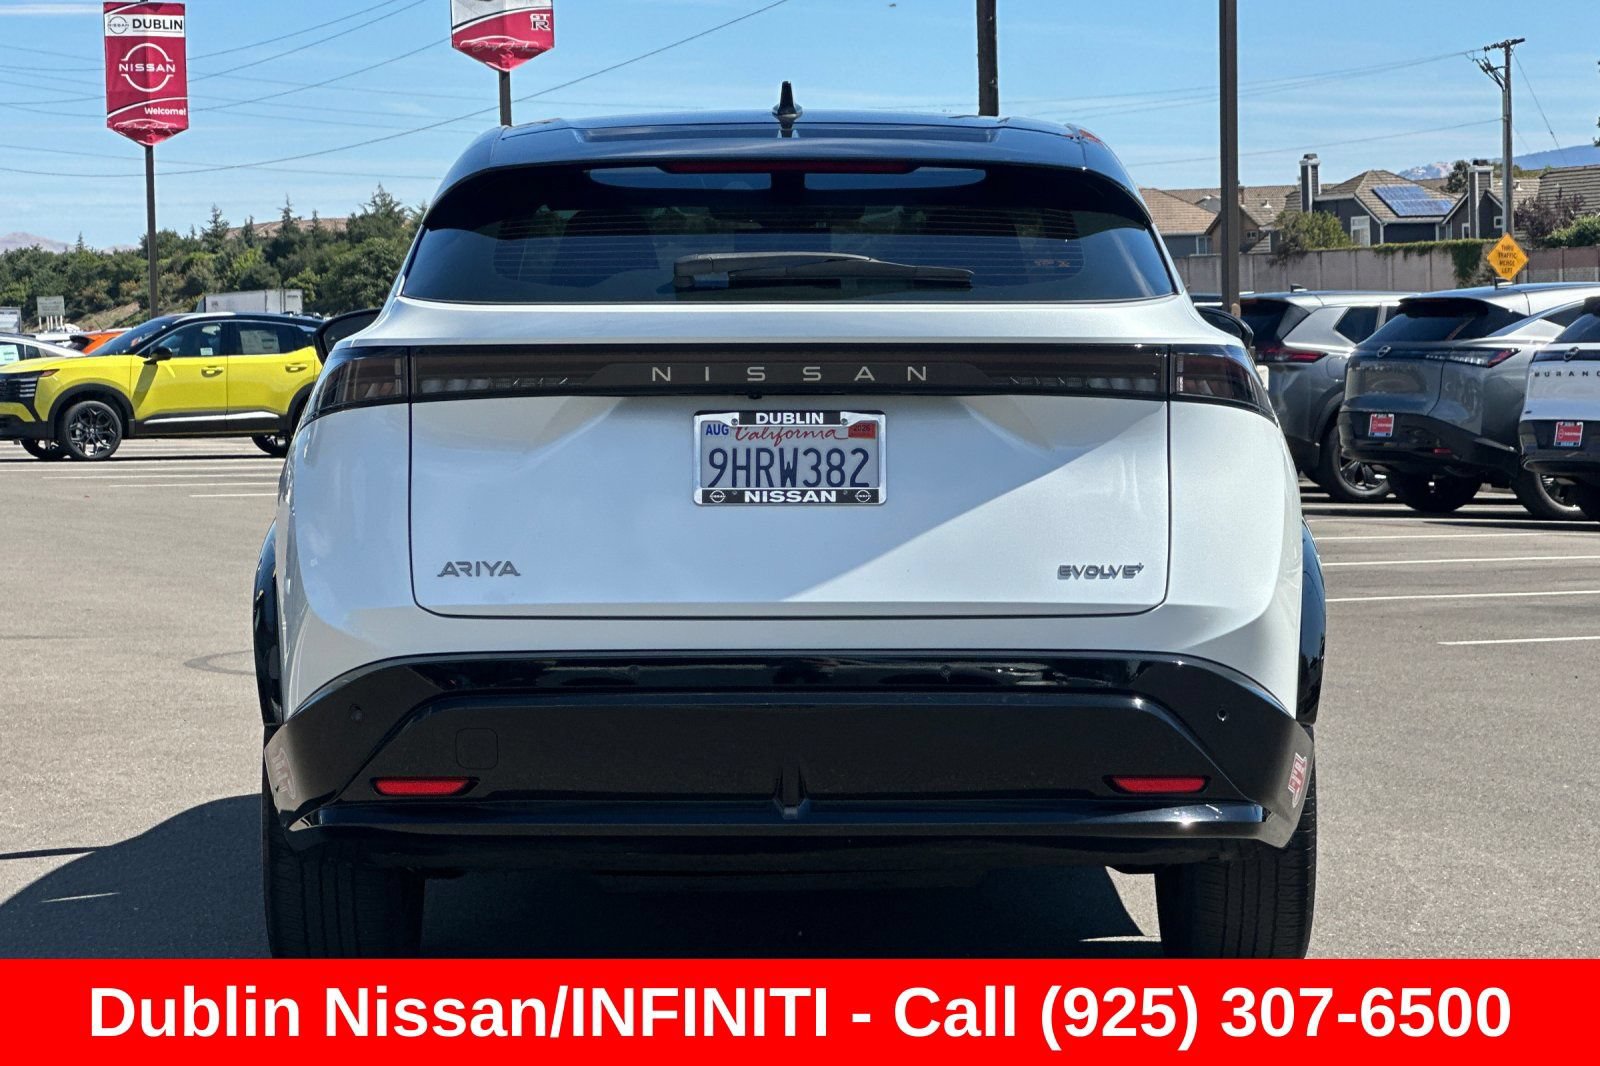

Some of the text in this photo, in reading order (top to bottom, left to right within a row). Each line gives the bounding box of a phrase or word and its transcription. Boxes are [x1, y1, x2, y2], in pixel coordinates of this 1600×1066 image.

[132, 18, 183, 30] DUBLIN
[118, 63, 176, 73] NISSAN
[144, 107, 186, 116] Welcome!
[651, 366, 928, 382] NISSAN
[755, 412, 825, 425] DUBLIN
[705, 424, 730, 436] AUG
[735, 426, 849, 447] California
[707, 448, 870, 488] 9HRW382
[744, 490, 837, 503] NISSAN
[437, 561, 521, 577] ARIYA
